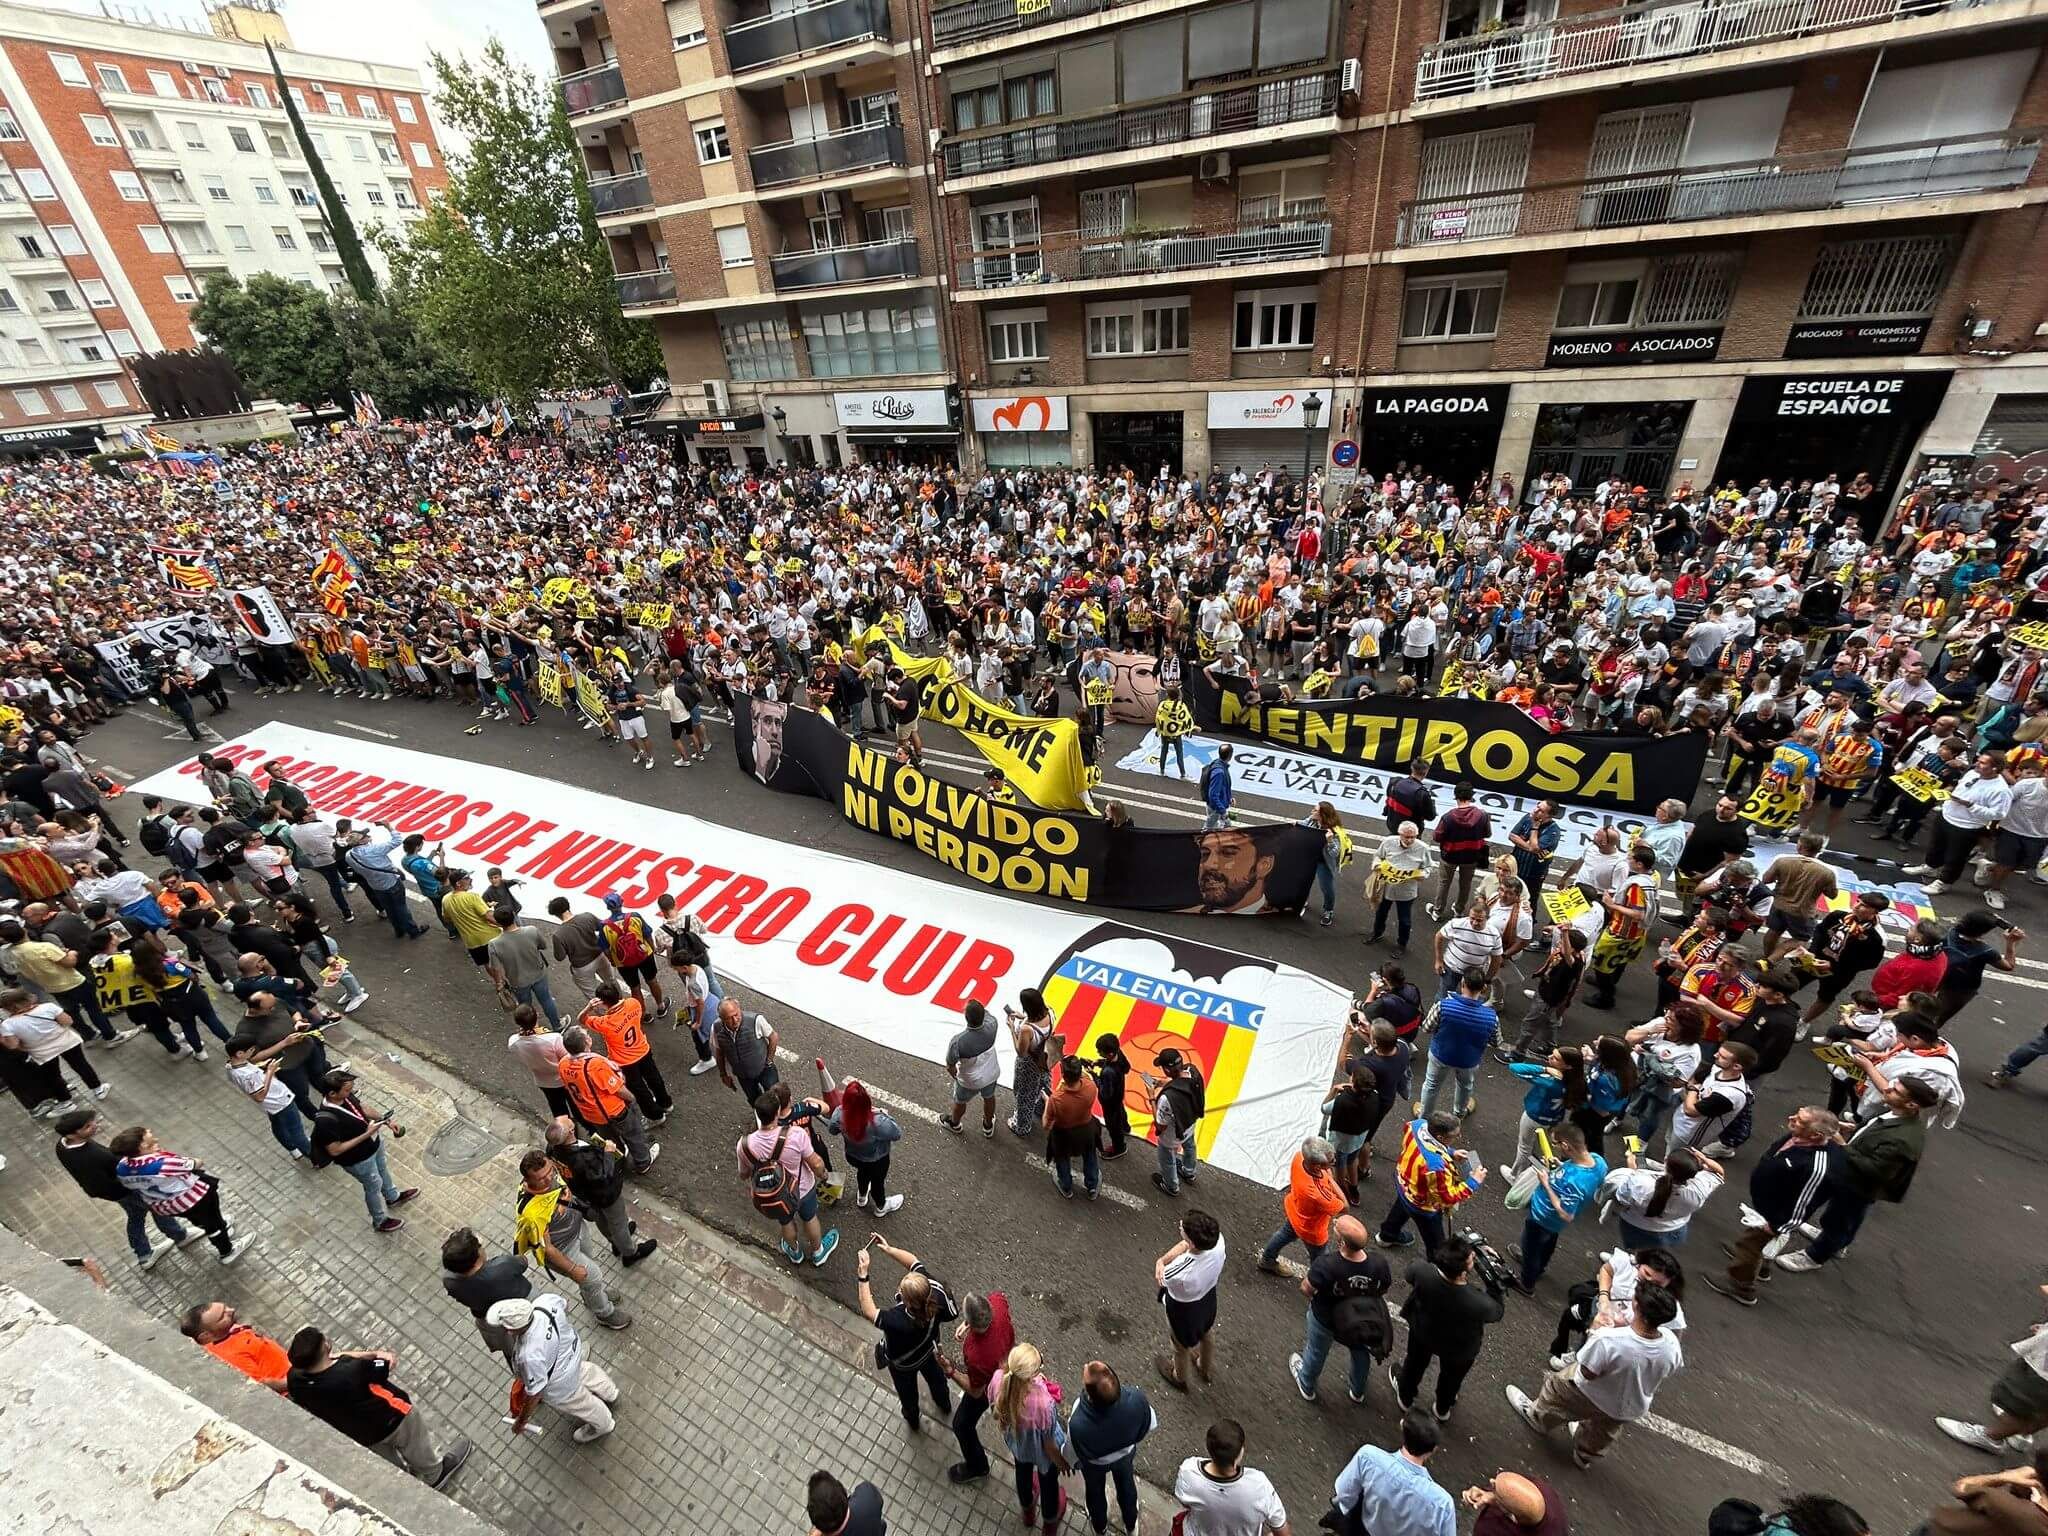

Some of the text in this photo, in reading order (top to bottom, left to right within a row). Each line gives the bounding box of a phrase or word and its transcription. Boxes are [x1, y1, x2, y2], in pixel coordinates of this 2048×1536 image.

[1796, 326, 1921, 338] ABOGADOS ECONOMISTAS
[1552, 336, 1715, 356] MORENO ASOCIADOS
[1783, 379, 1904, 394] ESCUELA DE
[1375, 397, 1489, 414] LA PAGODA
[1777, 395, 1891, 415] ESPAÑOL
[3, 428, 72, 442] DEPORTIVA
[918, 674, 959, 719] GO
[965, 702, 1056, 774] HOME
[1220, 691, 1635, 801] MENTIROSA
[848, 739, 1079, 856] NI OLVIDO
[1241, 769, 1385, 804] EL VALEN
[1744, 800, 1800, 824] OME
[844, 788, 1090, 902] NI PERDÓN
[453, 811, 558, 866] DE
[517, 829, 812, 945] NUESTRO
[794, 903, 1015, 1014] CLUB
[101, 984, 147, 1009] ME
[1075, 960, 1235, 1022] VALENCIA
[624, 1025, 637, 1048] 9
